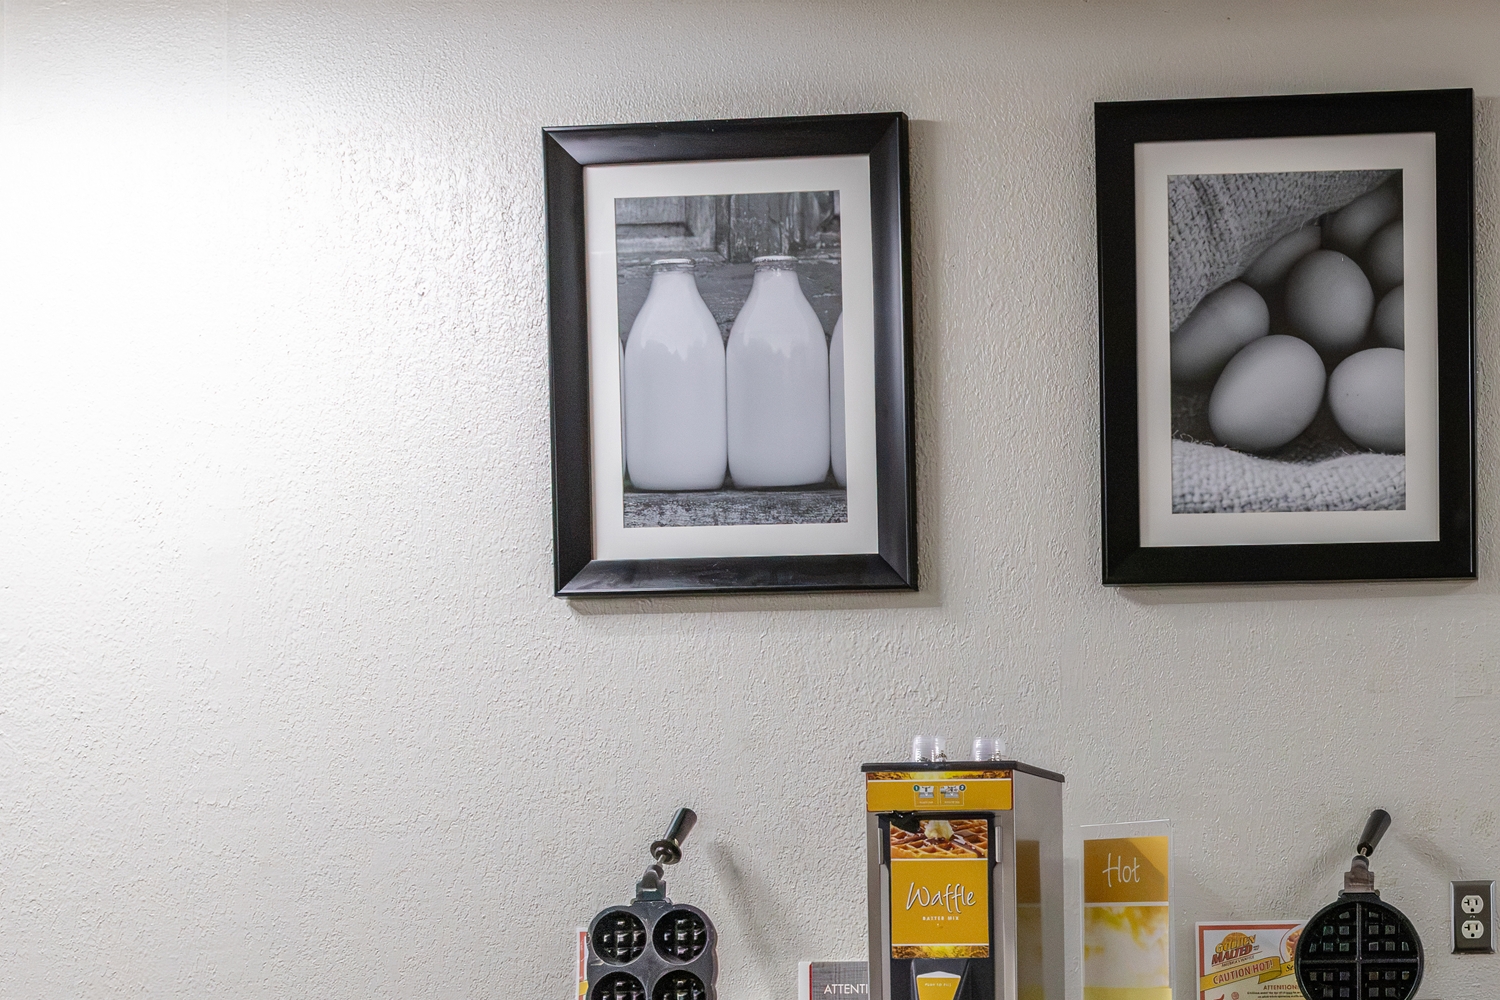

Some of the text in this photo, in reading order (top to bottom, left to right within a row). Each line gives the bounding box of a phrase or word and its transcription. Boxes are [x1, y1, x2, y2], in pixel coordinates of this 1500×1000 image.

[1102, 852, 1141, 888] Hot
[906, 882, 976, 914] Waffle
[1211, 945, 1253, 965] MALTED
[1213, 968, 1251, 985] CAUTION
[1253, 959, 1273, 974] HOT!
[824, 984, 868, 994] ATTENTI
